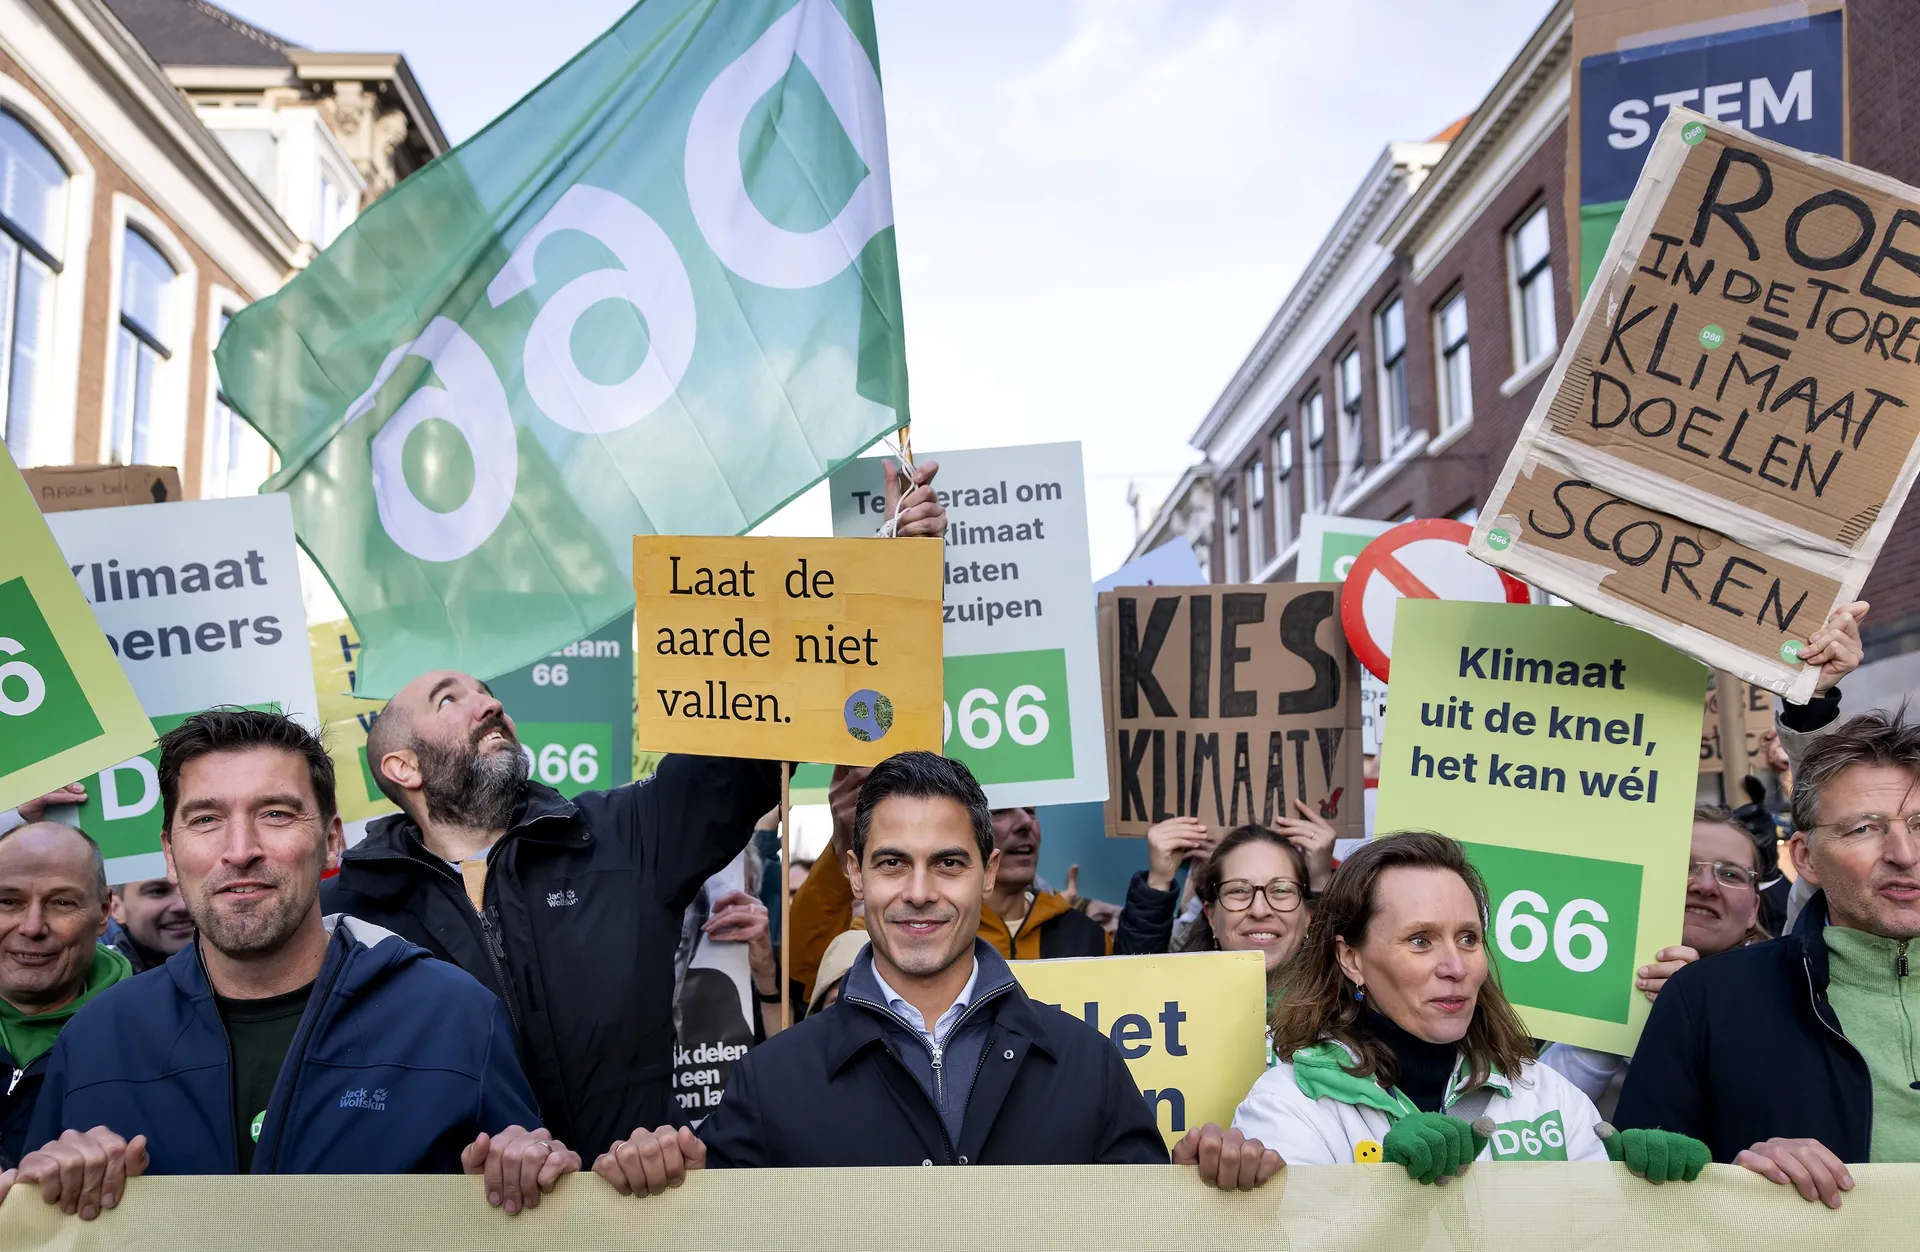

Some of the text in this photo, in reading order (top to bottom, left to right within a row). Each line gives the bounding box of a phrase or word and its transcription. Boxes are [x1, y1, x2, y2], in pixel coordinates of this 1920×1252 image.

[1607, 69, 1813, 150] STEM
[1684, 126, 1703, 141] D66
[1639, 232, 1920, 365] IN DE TORE
[1703, 330, 1721, 343] D66
[1587, 370, 1844, 498] DOELEN
[851, 481, 1062, 515] Te eraal om
[1489, 532, 1507, 545] D66
[1528, 479, 1809, 633] SCOREN
[71, 550, 268, 605] limaat
[669, 556, 834, 599] Laat de
[944, 561, 1019, 585] laten
[943, 596, 1043, 627] zuipen
[656, 618, 879, 666] aarde niet
[1117, 590, 1342, 719] KIES
[1783, 645, 1798, 656] D6
[532, 663, 569, 687] 66
[1458, 645, 1627, 690] Klimaat
[657, 680, 791, 724] vallen.
[943, 684, 1050, 750] 66
[1420, 696, 1657, 757] uit de knel,
[529, 743, 600, 784] 66
[1411, 746, 1660, 804] het kan wél
[546, 890, 566, 901] Jack
[1494, 889, 1610, 973] 66
[693, 1041, 748, 1063] delen
[341, 1087, 368, 1100] Jack
[680, 1068, 720, 1087] een
[704, 1086, 725, 1108] la
[339, 1096, 386, 1111] Wolfskin
[1491, 1119, 1565, 1156] D66
